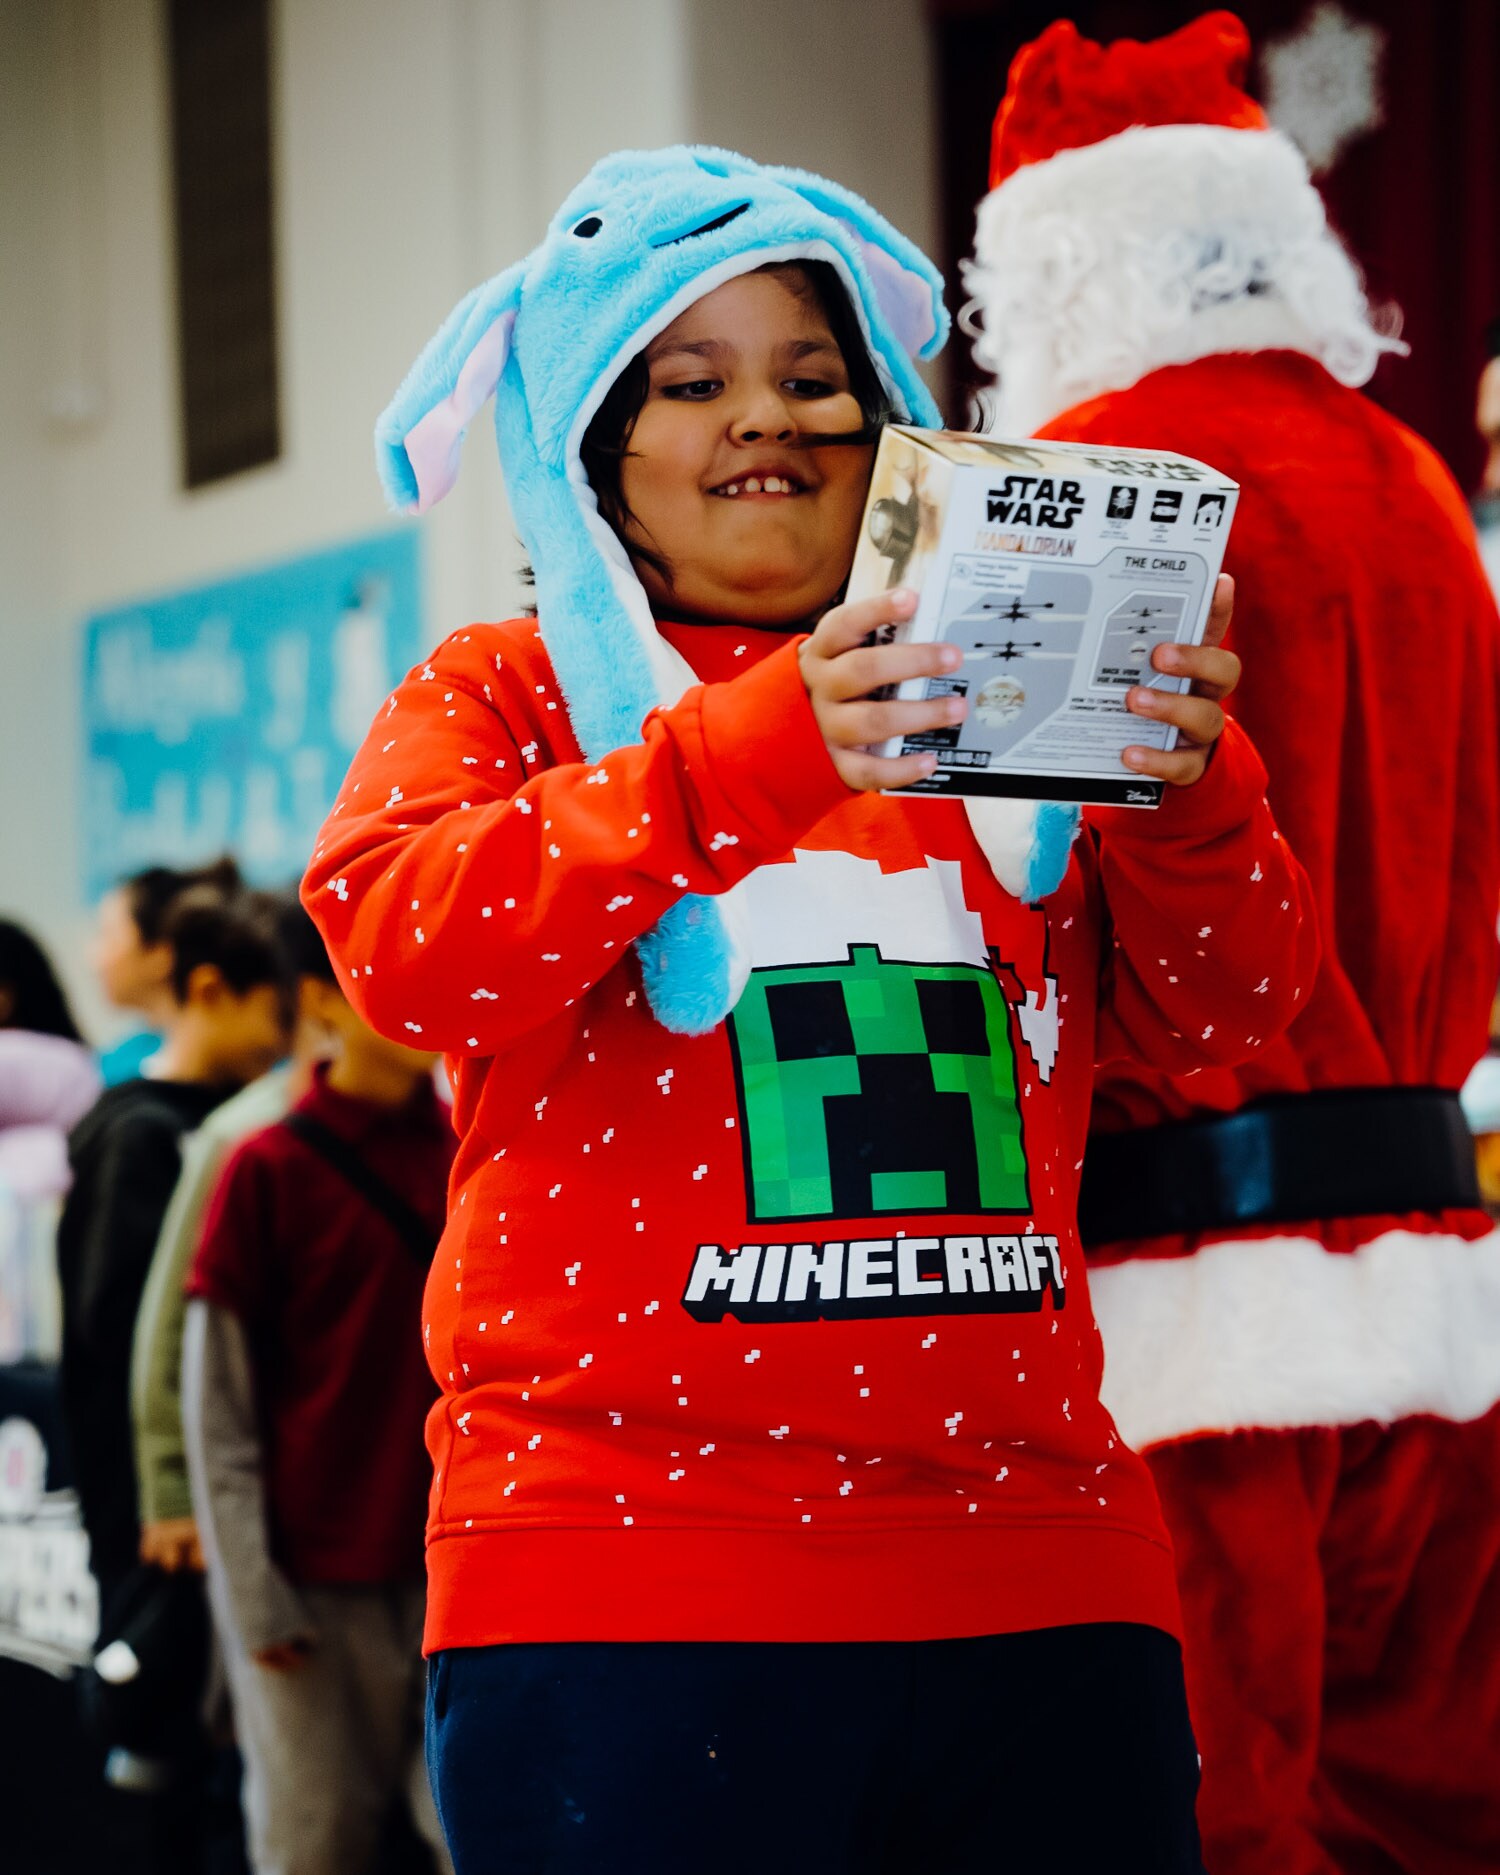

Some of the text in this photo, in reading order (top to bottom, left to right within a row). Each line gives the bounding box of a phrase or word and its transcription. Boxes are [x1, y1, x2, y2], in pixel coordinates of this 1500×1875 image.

[988, 475, 1085, 505] STAR
[987, 499, 1083, 529] WARS
[1124, 556, 1187, 571] THE CHILD
[683, 1234, 1066, 1323] MINECRAFT
